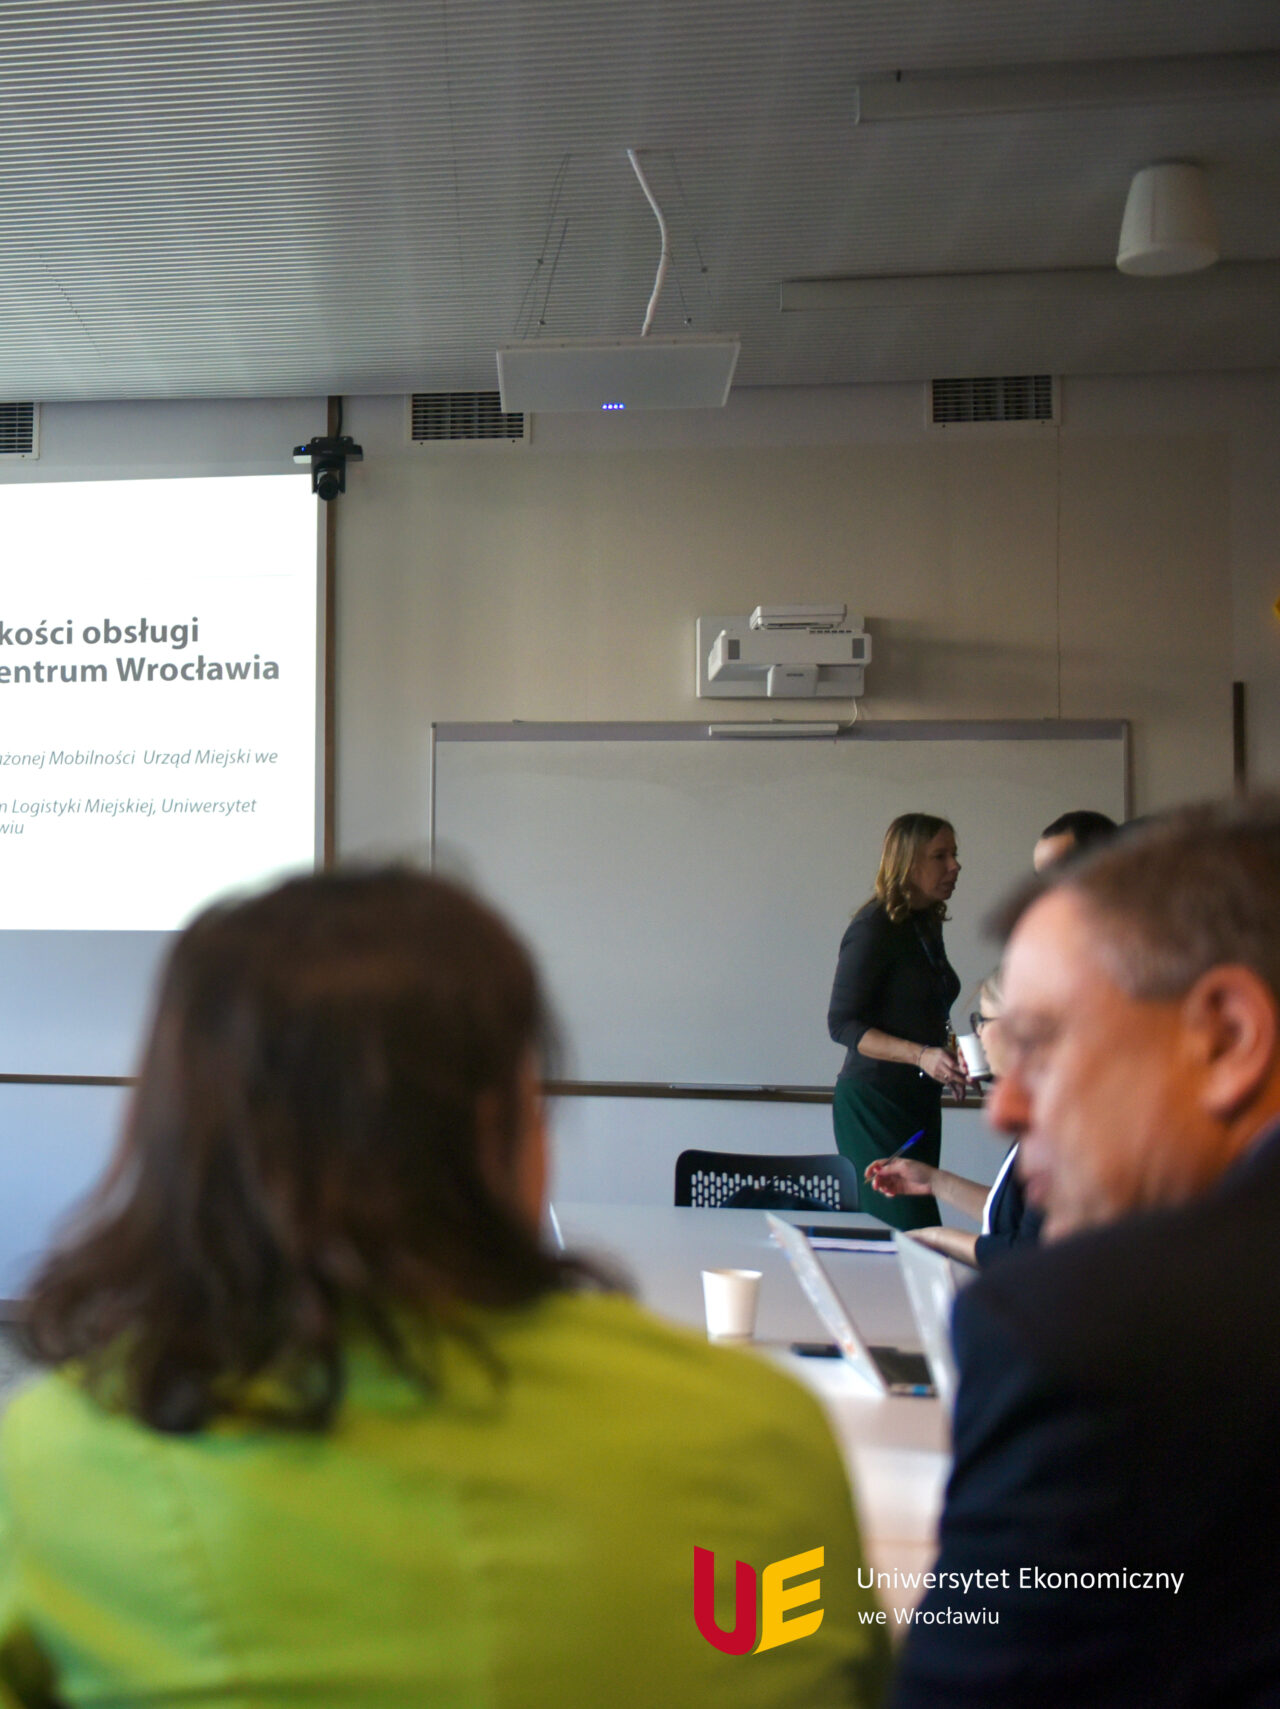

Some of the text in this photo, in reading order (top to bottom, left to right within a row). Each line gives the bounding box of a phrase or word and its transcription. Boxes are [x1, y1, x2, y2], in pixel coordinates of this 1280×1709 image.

[83, 616, 198, 650] obsługi
[116, 654, 279, 681] Wrocławia
[49, 750, 136, 765] Mobilności
[144, 749, 192, 768] Urząd
[195, 748, 251, 768] Miejski
[255, 752, 278, 763] we
[12, 798, 81, 817] Logistyki
[85, 798, 156, 817] Miejskiej,
[162, 798, 257, 816] Uniwersytet
